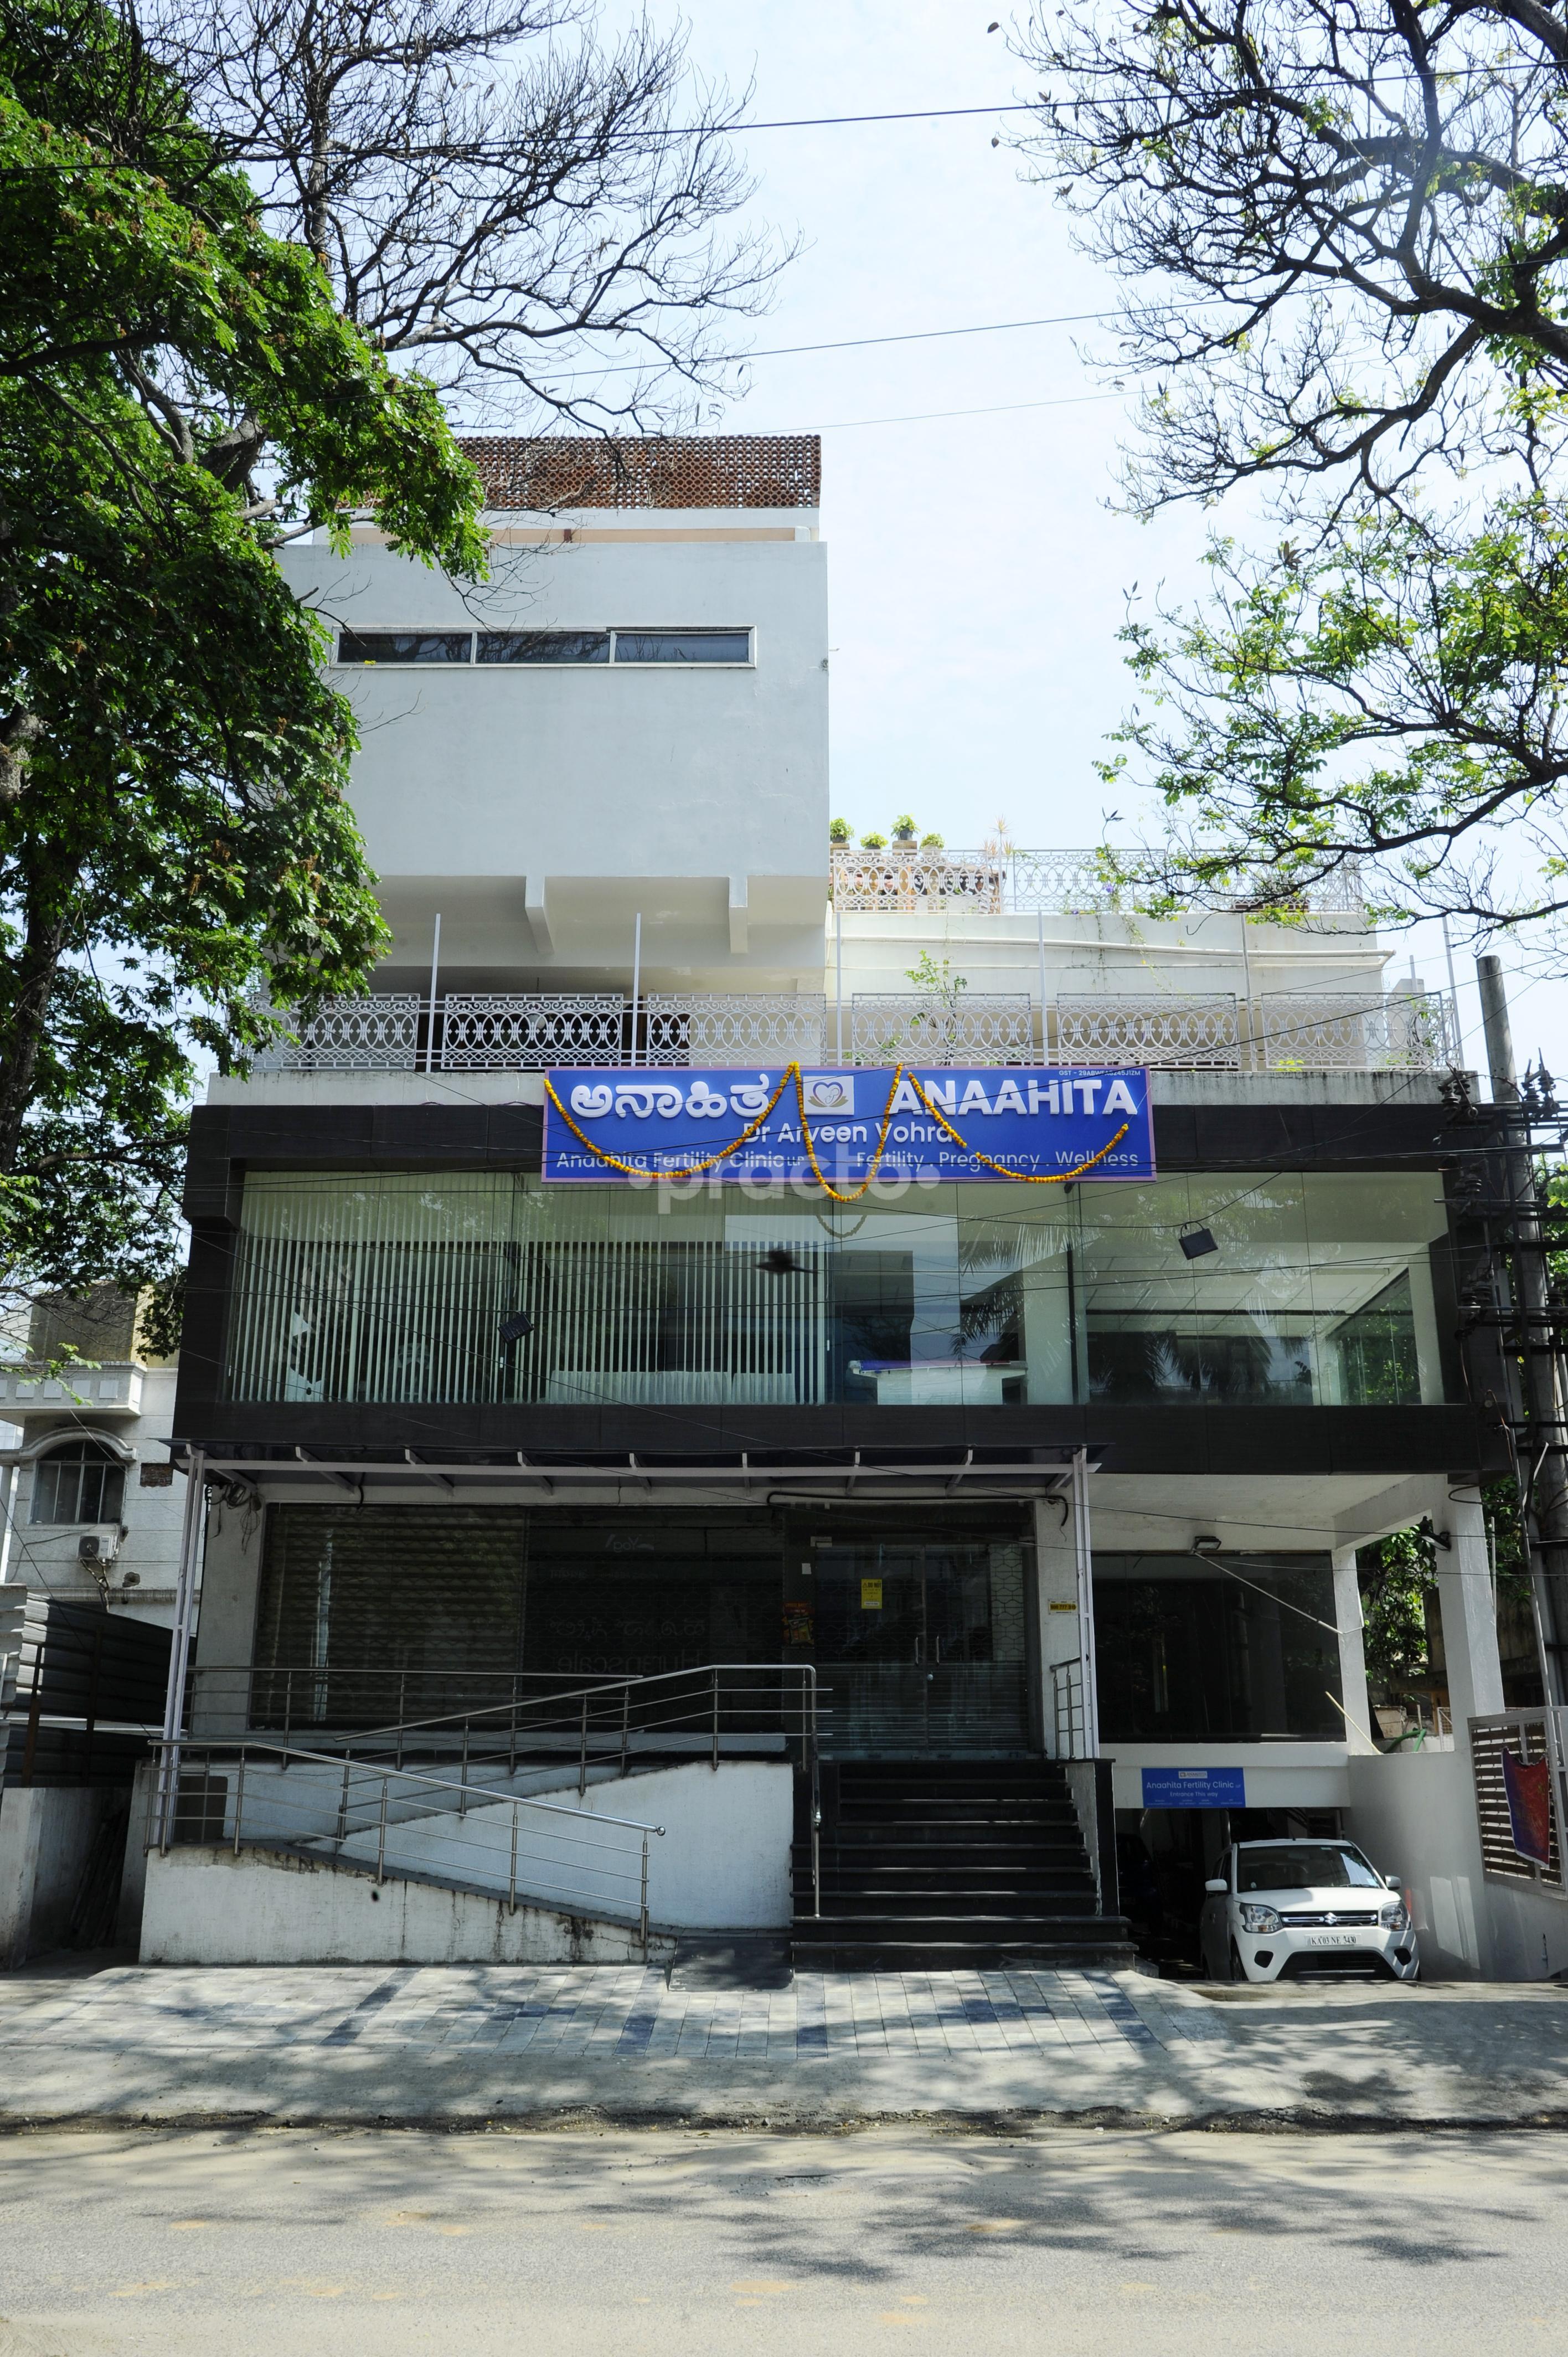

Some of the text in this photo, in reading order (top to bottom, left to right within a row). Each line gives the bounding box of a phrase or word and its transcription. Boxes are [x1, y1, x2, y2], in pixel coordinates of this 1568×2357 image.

[570, 1073, 771, 1118] ಅನಾಹಿತ
[889, 1079, 1138, 1115] ANAAHITA
[744, 1121, 952, 1143] Dr Arveen Vohra
[729, 1150, 785, 1168] Clinic
[857, 1150, 925, 1172] Fertility
[1184, 1781, 1211, 1790] Fertility
